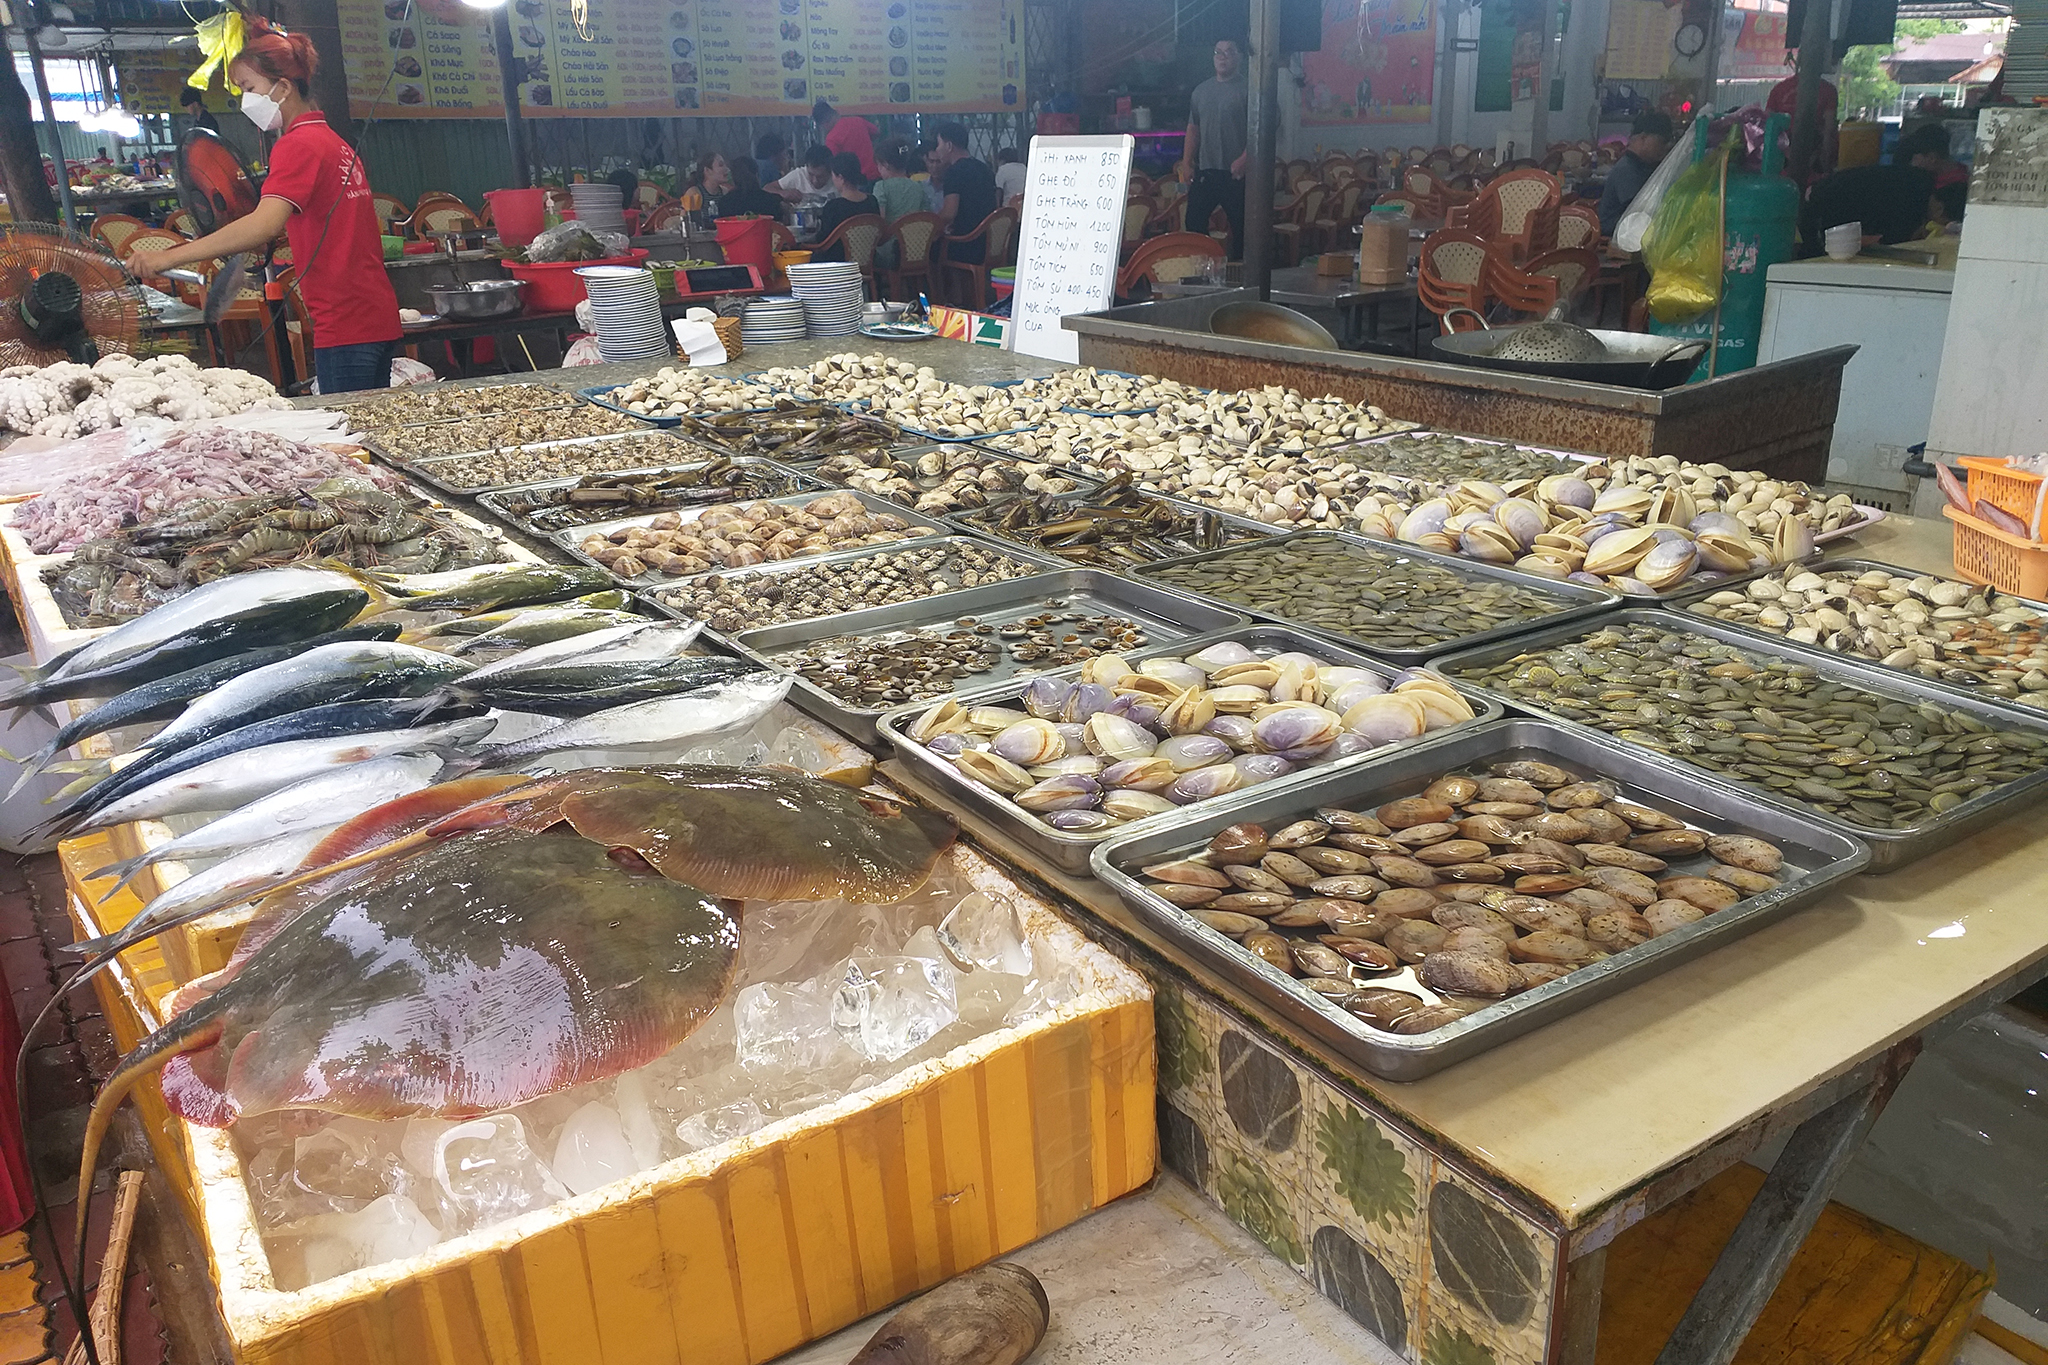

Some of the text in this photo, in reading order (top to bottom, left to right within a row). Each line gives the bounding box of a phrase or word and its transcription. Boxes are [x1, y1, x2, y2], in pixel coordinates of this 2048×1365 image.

[1064, 154, 1087, 164] XANH
[1101, 152, 1120, 167] 850
[1098, 173, 1117, 190] 650
[1096, 196, 1113, 211] 600
[1036, 212, 1055, 229] TÔM
[1089, 220, 1112, 232] 1200
[1033, 232, 1052, 250] TÔM
[1094, 241, 1108, 254] 900
[1029, 255, 1047, 271] TÔM
[1026, 275, 1046, 291] TÔM
[1024, 319, 1043, 332] CUA
